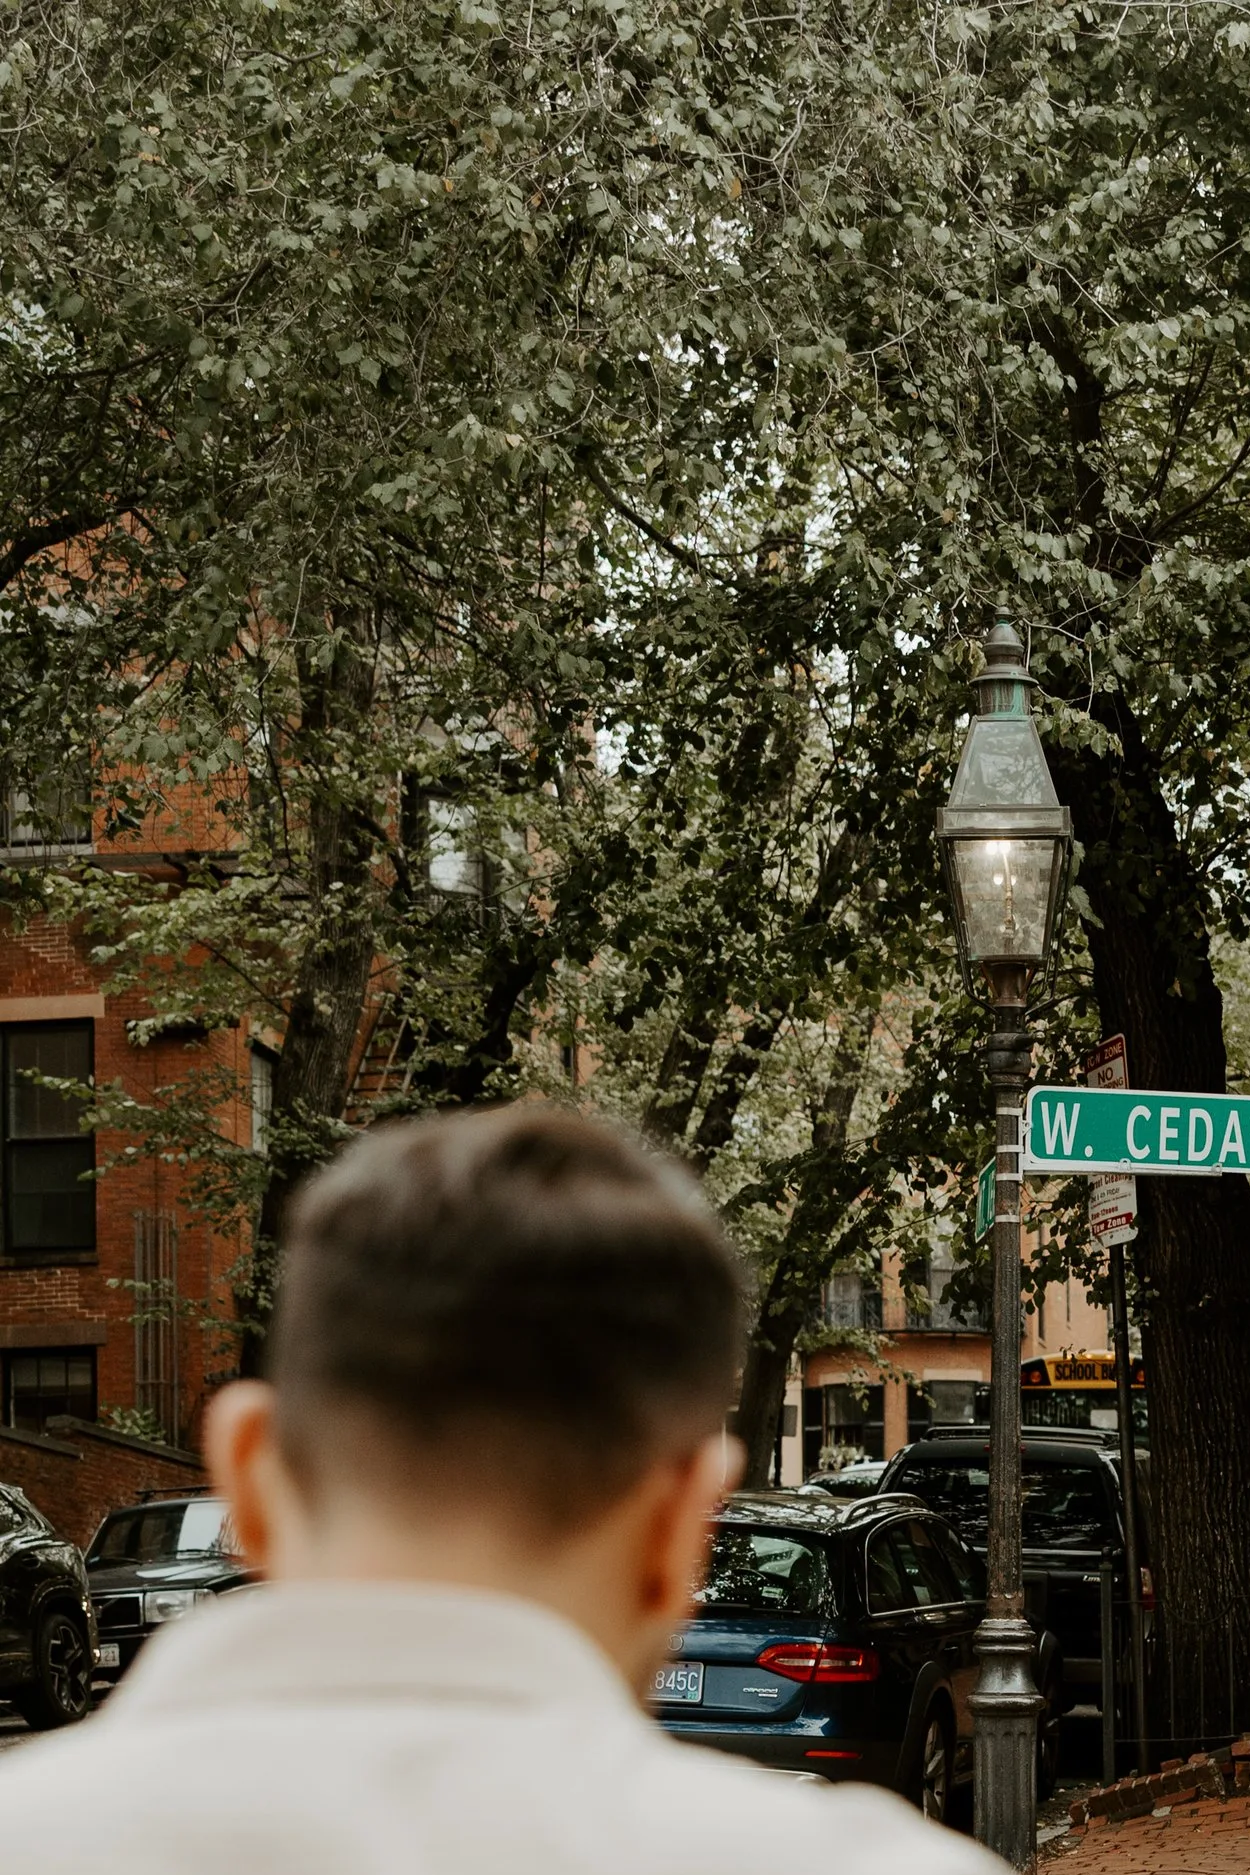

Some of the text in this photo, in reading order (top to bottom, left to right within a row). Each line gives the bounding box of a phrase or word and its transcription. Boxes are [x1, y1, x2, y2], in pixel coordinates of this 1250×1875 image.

[1104, 1042, 1123, 1060] ZONE
[1097, 1067, 1113, 1086] NO
[1040, 1101, 1094, 1158] W.
[1093, 1223, 1105, 1235] Tow
[1107, 1217, 1127, 1229] Zone
[1055, 1363, 1119, 1381] SCHOOL BU
